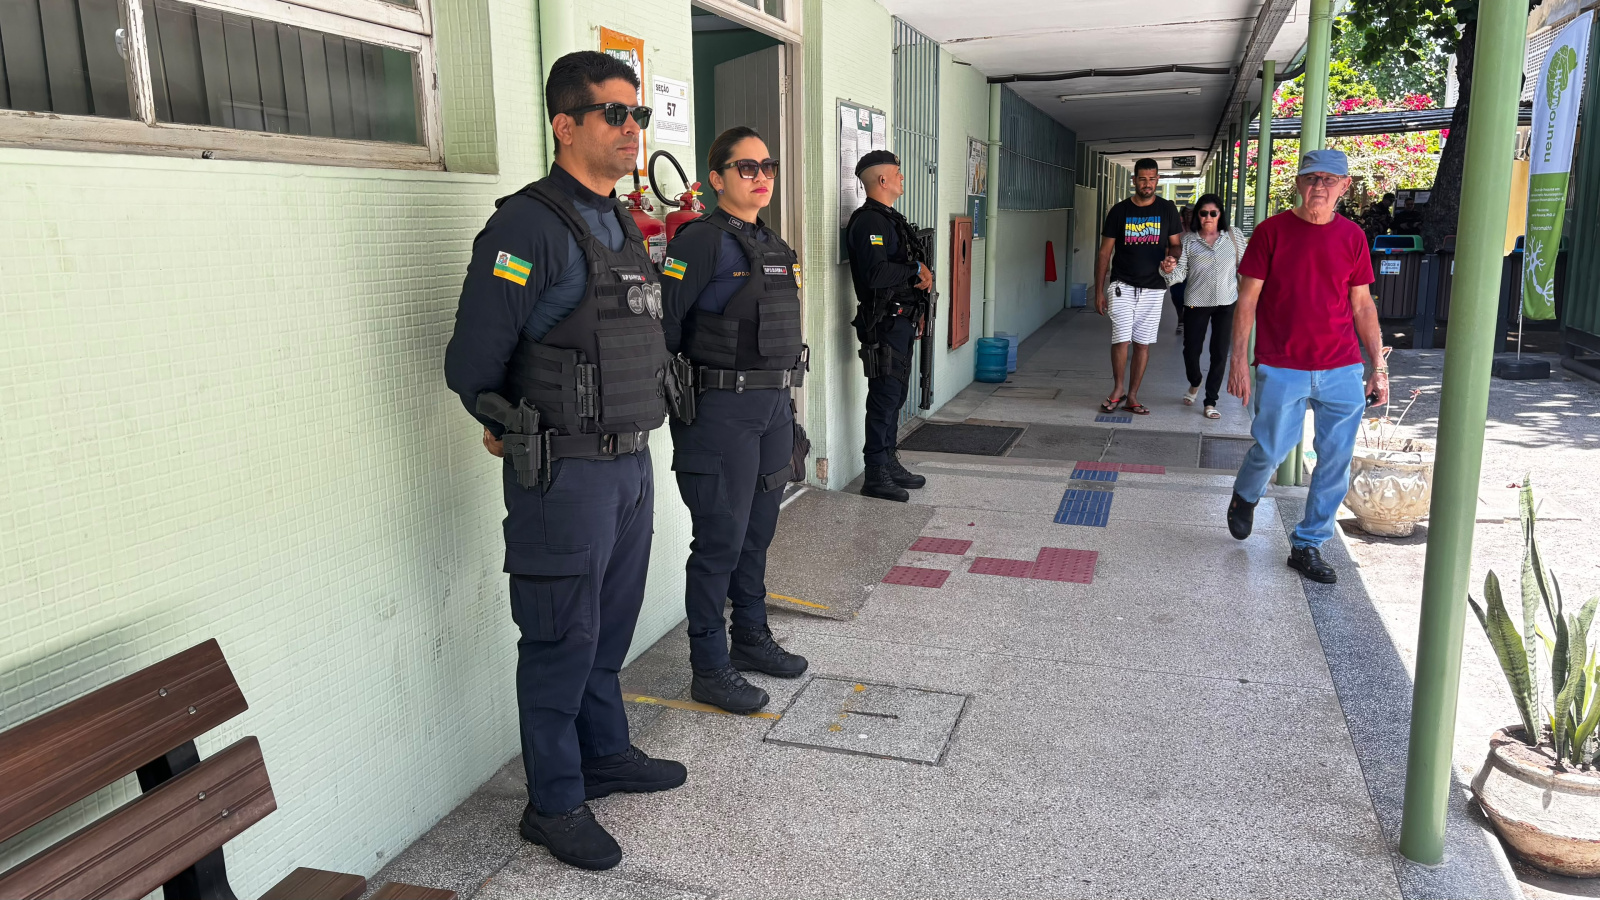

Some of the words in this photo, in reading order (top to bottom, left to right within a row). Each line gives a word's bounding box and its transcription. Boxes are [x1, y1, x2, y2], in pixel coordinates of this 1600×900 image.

[655, 83, 669, 93] SEÇÃO
[666, 102, 676, 117] 57
[1125, 222, 1161, 232] HAWAII
